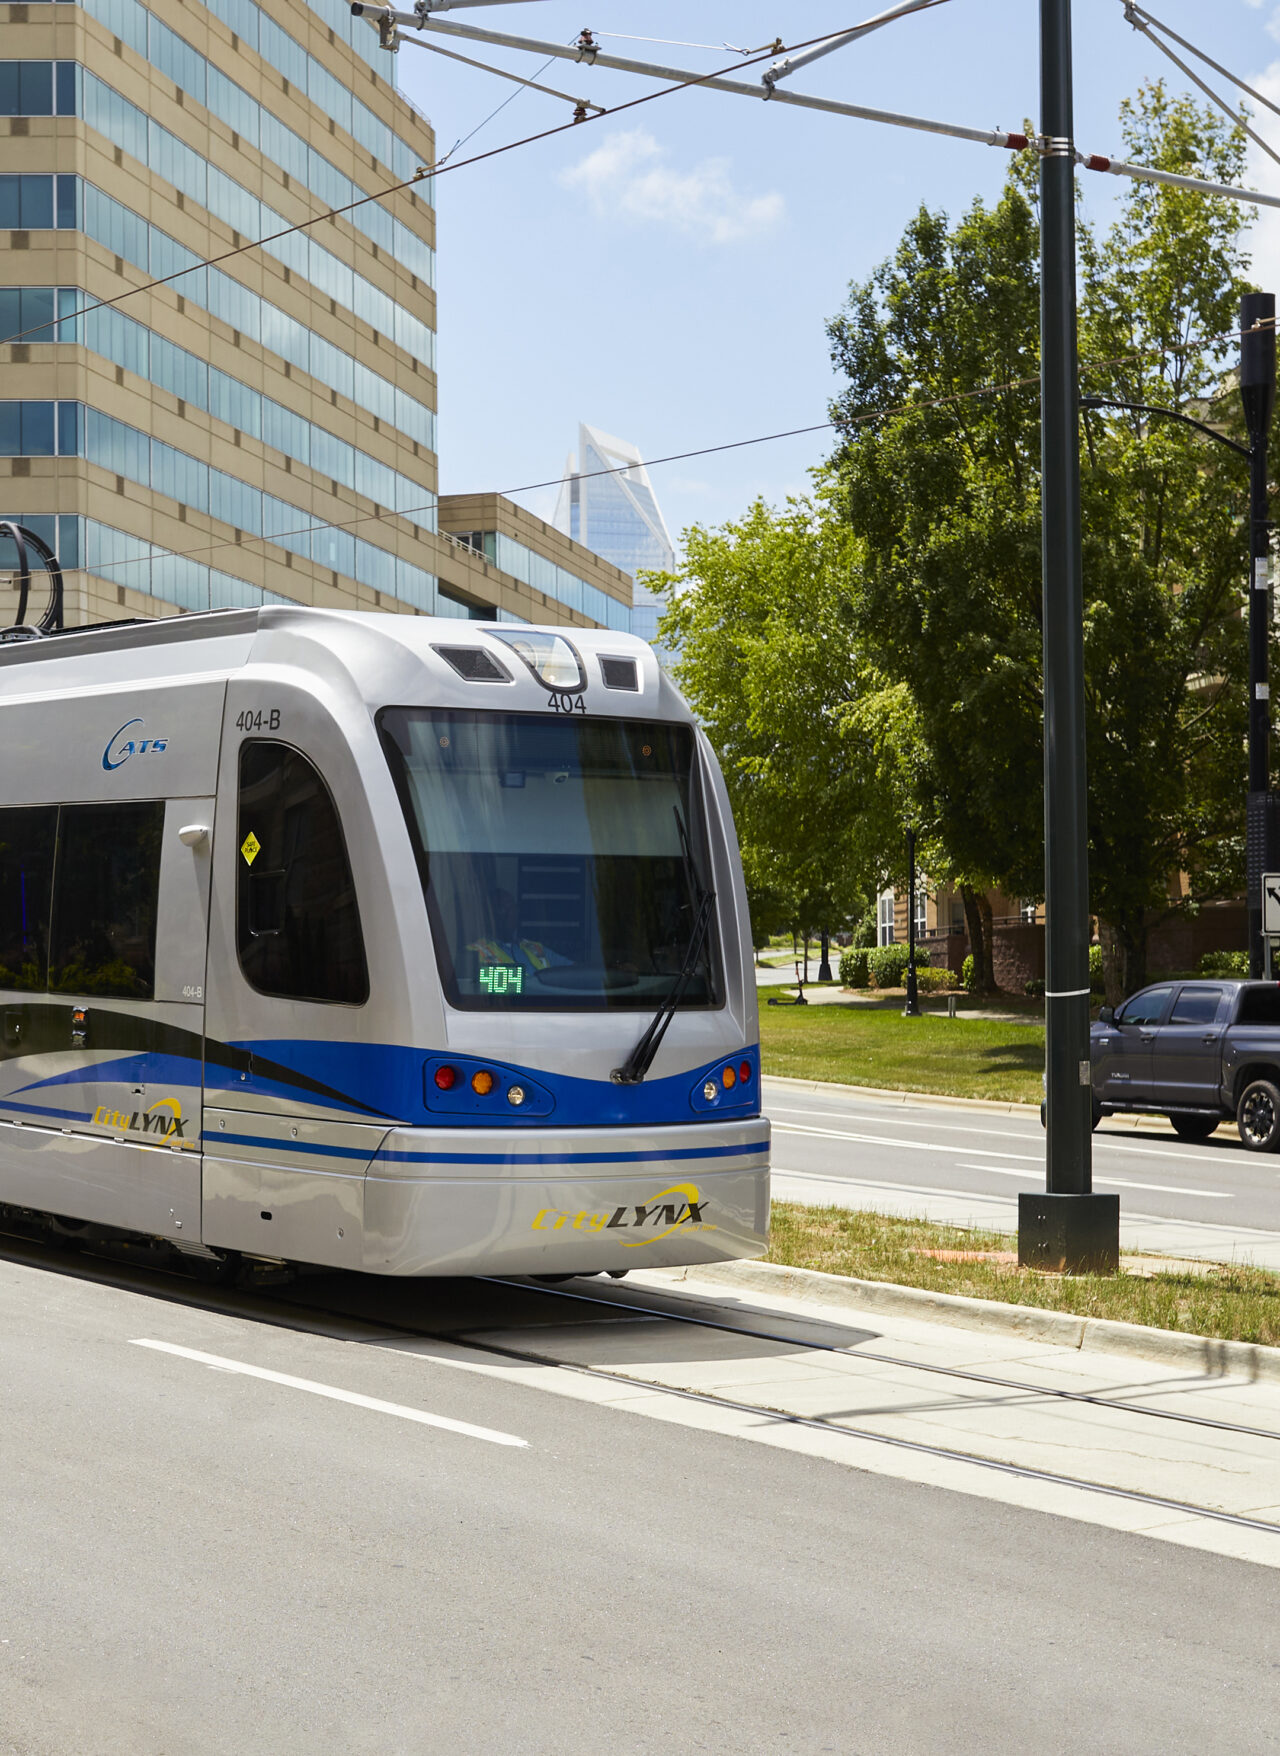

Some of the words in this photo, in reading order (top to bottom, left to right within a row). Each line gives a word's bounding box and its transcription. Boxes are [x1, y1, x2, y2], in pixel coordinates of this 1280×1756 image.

[548, 692, 587, 714] 404
[235, 709, 281, 732] 404-B
[102, 718, 169, 771] CATS
[182, 984, 202, 998] 404-B
[479, 966, 522, 994] 404
[94, 1105, 190, 1138] CityLYNX
[531, 1201, 710, 1233] CityLYNX
